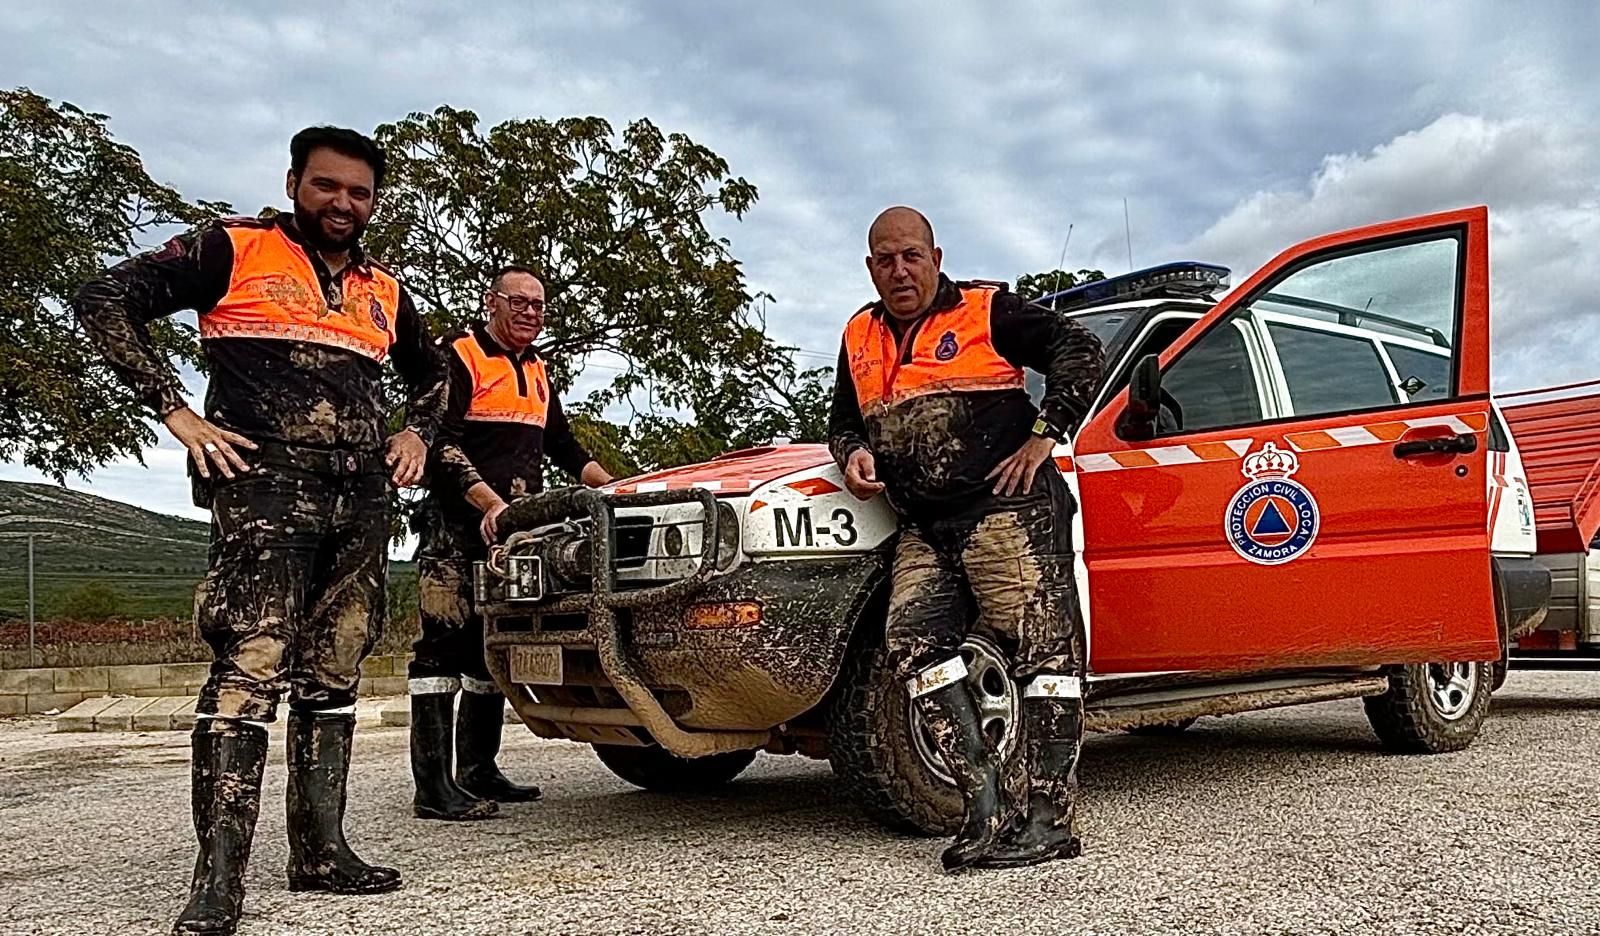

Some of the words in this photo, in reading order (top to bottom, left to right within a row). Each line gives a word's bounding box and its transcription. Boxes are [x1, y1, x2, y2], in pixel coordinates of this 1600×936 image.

[773, 506, 858, 547] M-3
[1232, 484, 1269, 546] PROTECCION
[1273, 484, 1299, 501] CIVIL
[1296, 502, 1312, 540] LOCAL
[1248, 545, 1298, 559] ZAMORA
